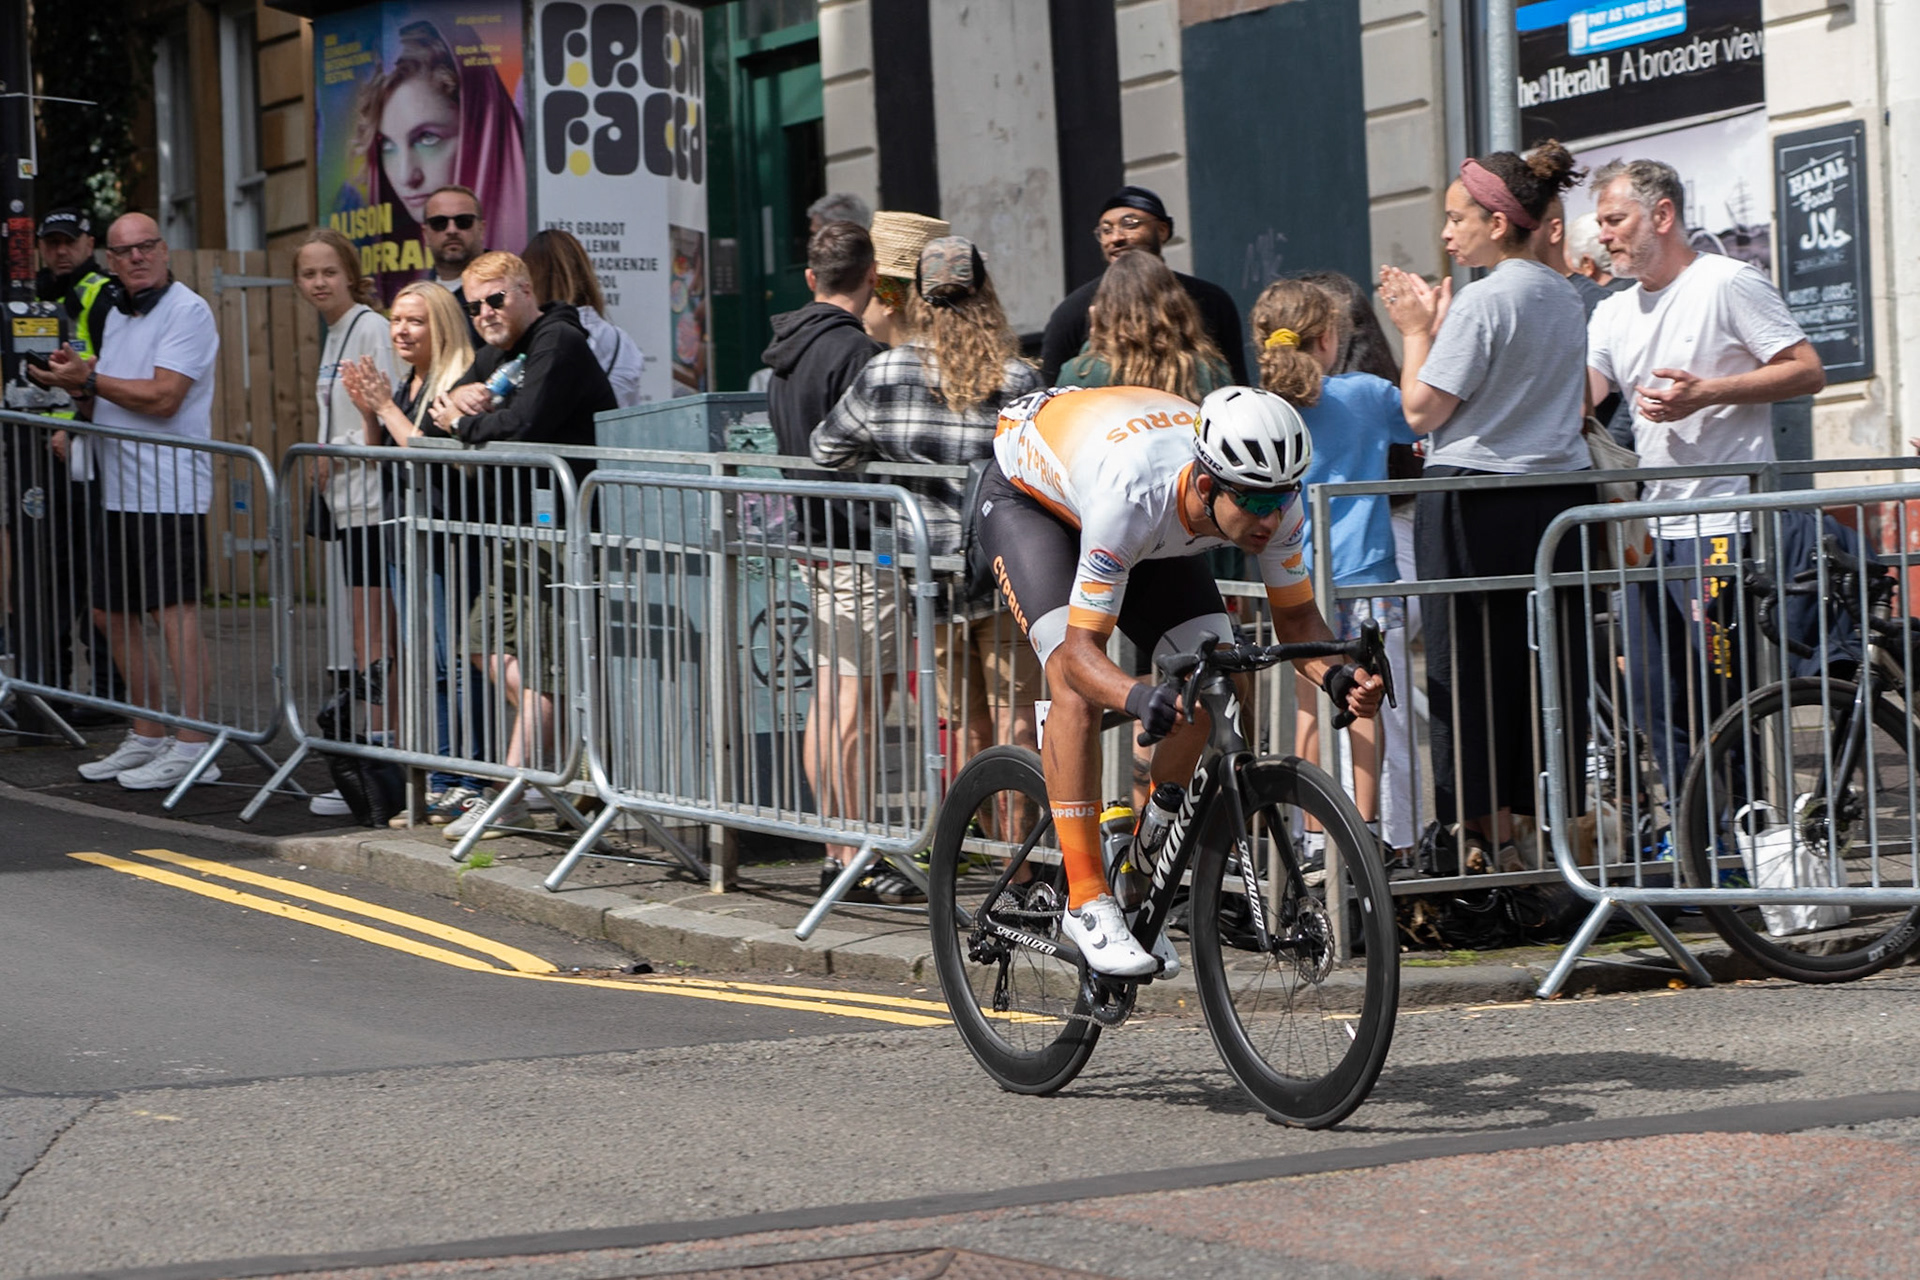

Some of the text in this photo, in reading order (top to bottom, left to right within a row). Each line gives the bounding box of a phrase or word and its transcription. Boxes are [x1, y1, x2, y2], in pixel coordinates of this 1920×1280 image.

[1608, 8, 1624, 22] AS
[1624, 2, 1646, 18] YOU
[1517, 76, 1540, 107] he
[1547, 57, 1611, 101] Herald
[1618, 51, 1637, 85] A
[1639, 36, 1720, 80] broader
[1788, 157, 1849, 197] HALAL
[330, 203, 392, 240] ALISON
[576, 221, 625, 236] GRADOT
[360, 240, 435, 276] DFRA
[586, 240, 620, 253] LEMM
[1106, 411, 1193, 443] PRUS
[993, 555, 1028, 636] CYPRUS
[1051, 806, 1095, 818] YPRUS
[1236, 838, 1265, 931] SPECIALIZED
[994, 926, 1057, 955] SPECIALIZED
